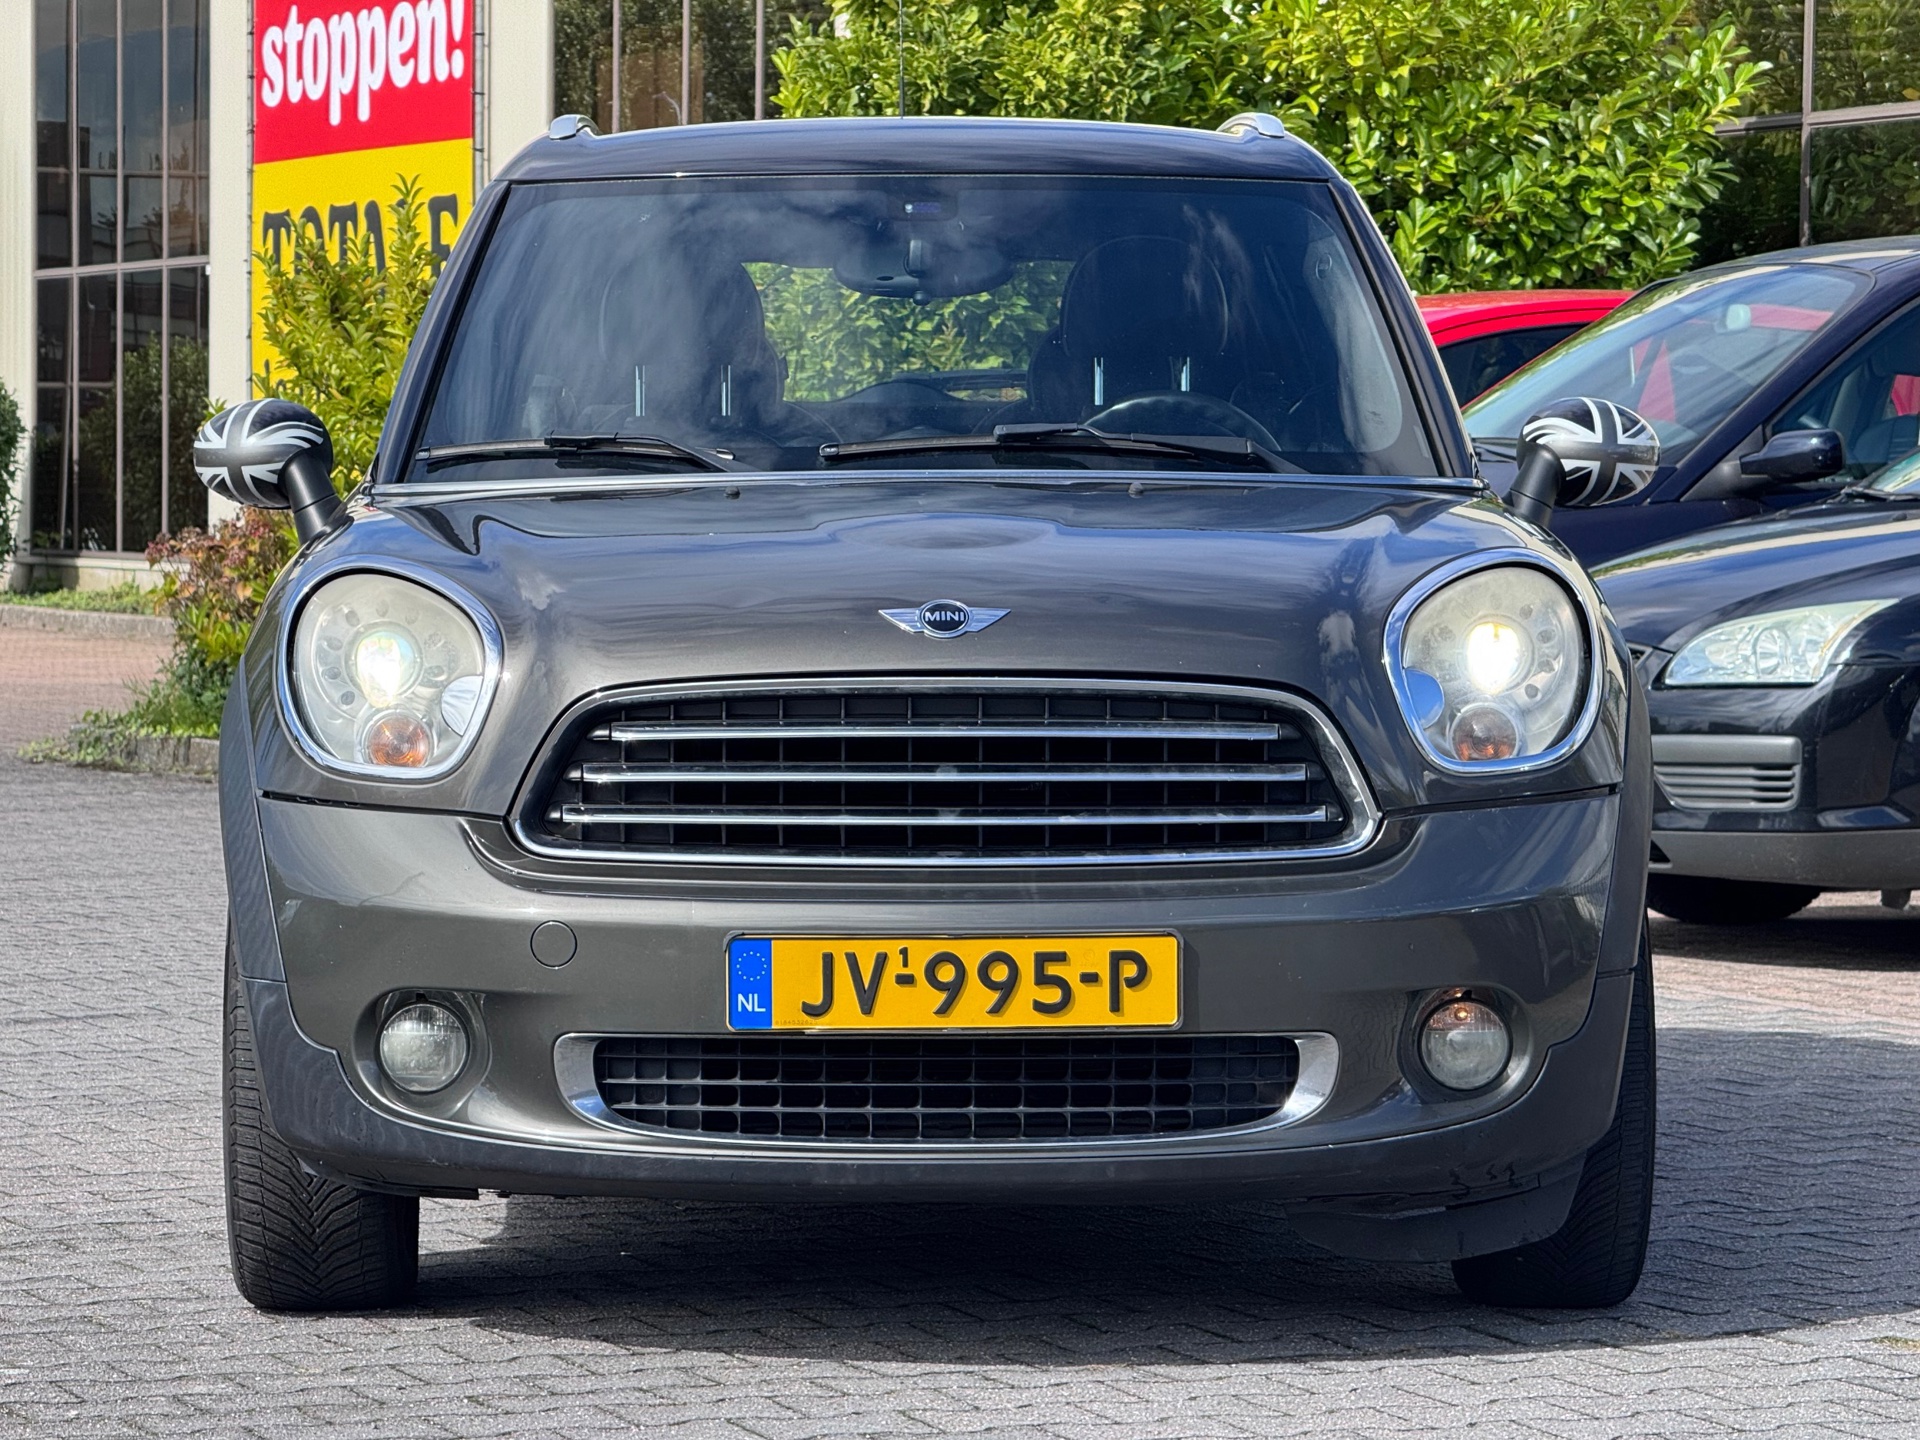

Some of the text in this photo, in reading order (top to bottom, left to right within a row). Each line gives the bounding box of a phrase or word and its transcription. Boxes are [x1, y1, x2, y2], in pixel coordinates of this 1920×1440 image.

[261, 0, 465, 127] stoppen!
[262, 193, 459, 297] TOTAE
[924, 610, 965, 622] MINI
[737, 993, 766, 1012] NL
